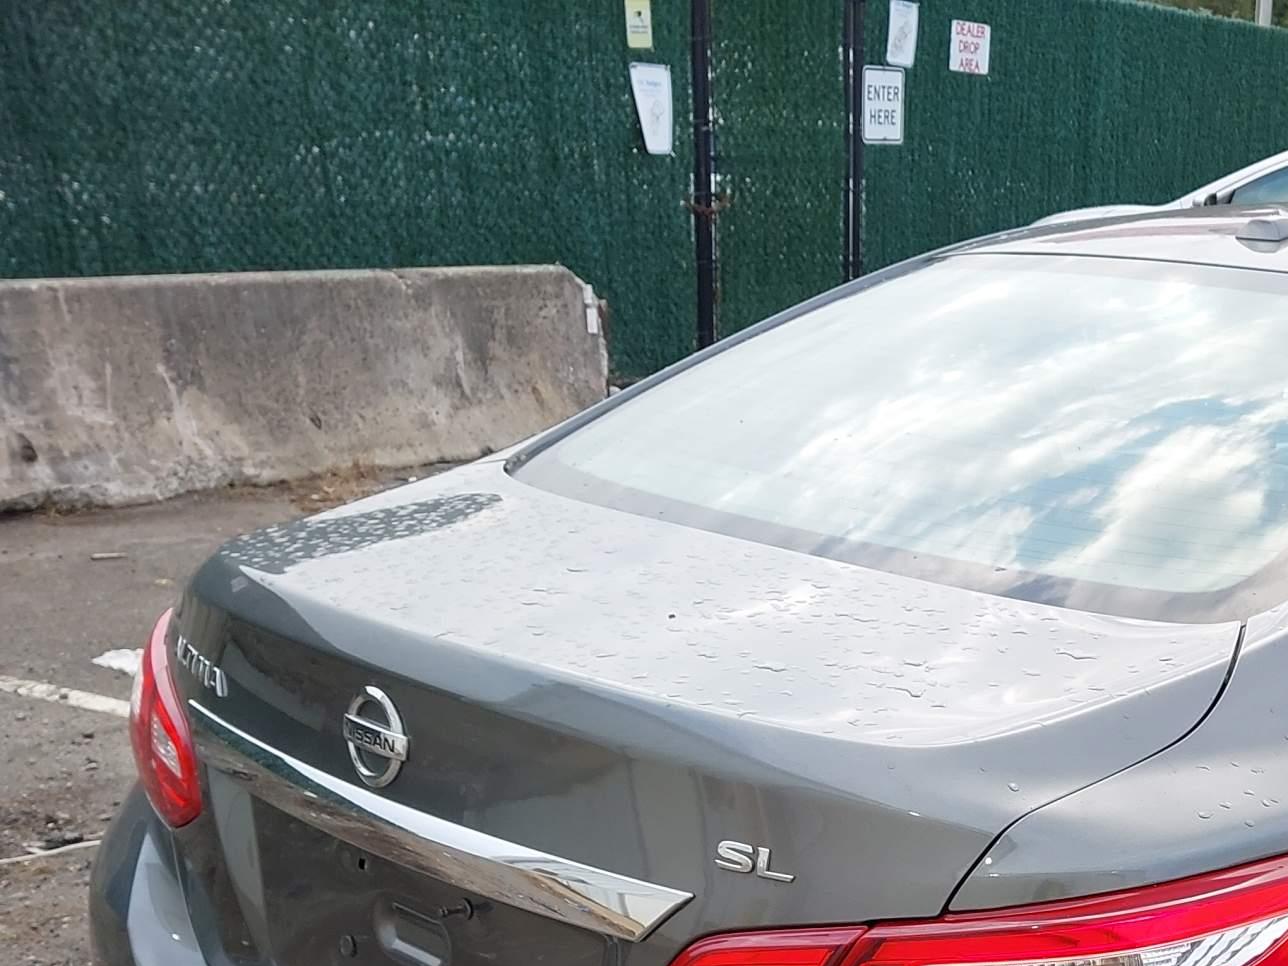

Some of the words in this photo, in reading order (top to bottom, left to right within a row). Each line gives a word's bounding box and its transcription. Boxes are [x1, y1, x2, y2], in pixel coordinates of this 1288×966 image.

[955, 22, 985, 38] DEALER
[958, 40, 979, 54] DROP
[959, 58, 979, 73] AREA
[867, 84, 899, 102] ENTER
[869, 109, 896, 125] HERE
[346, 719, 395, 753] NISSAN
[714, 840, 795, 882] SL
